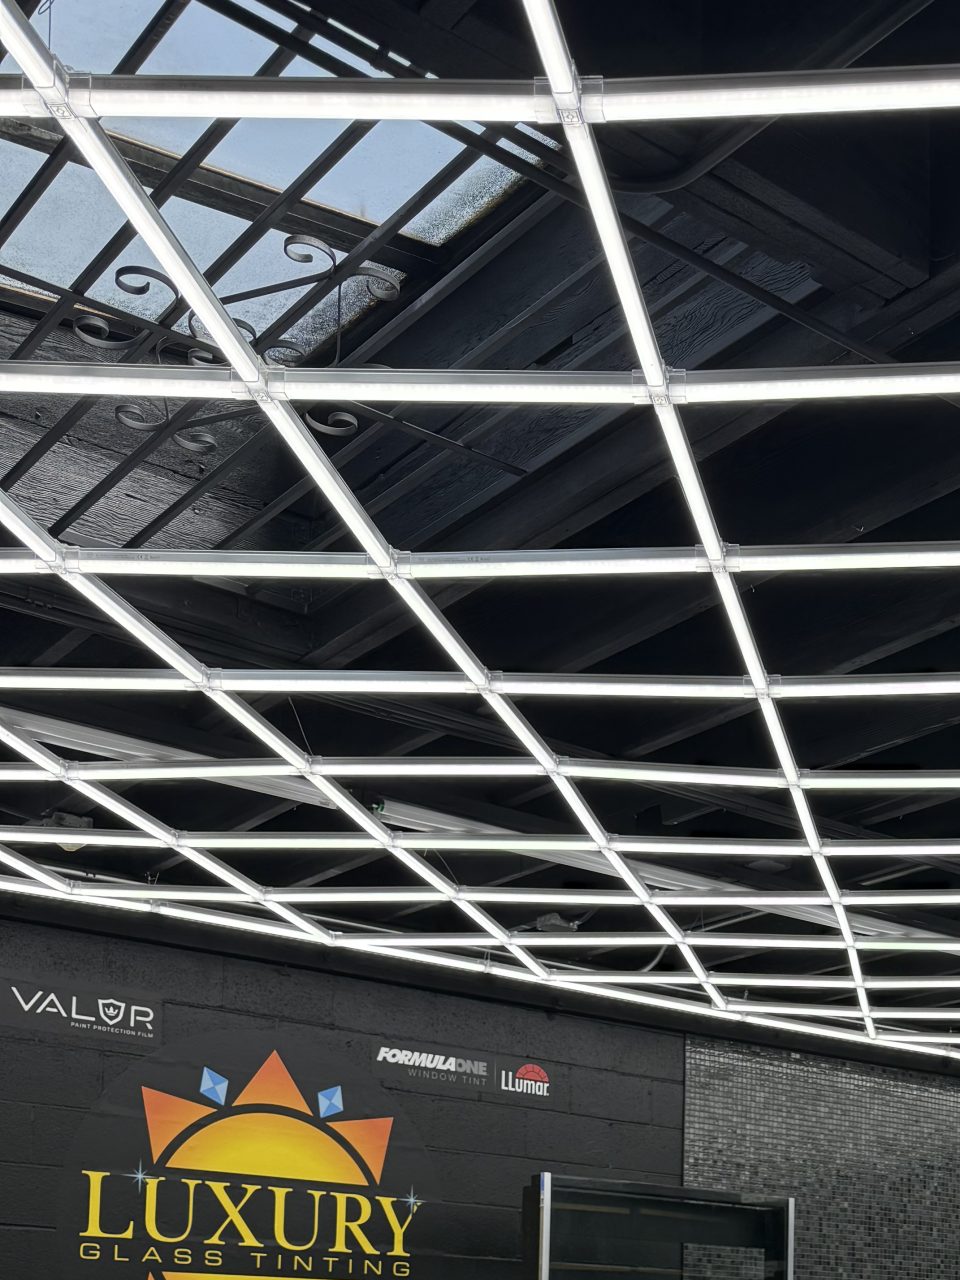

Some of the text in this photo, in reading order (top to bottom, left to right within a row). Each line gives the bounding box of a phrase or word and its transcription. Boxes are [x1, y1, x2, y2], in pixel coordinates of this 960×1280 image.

[11, 986, 154, 1030] VALOR
[70, 1021, 154, 1039] PAINT PROTECTION FILM
[407, 1068, 488, 1087] WINDOW TINT
[79, 1169, 424, 1258] LUXURY
[79, 1242, 411, 1278] GLASS TINTING
